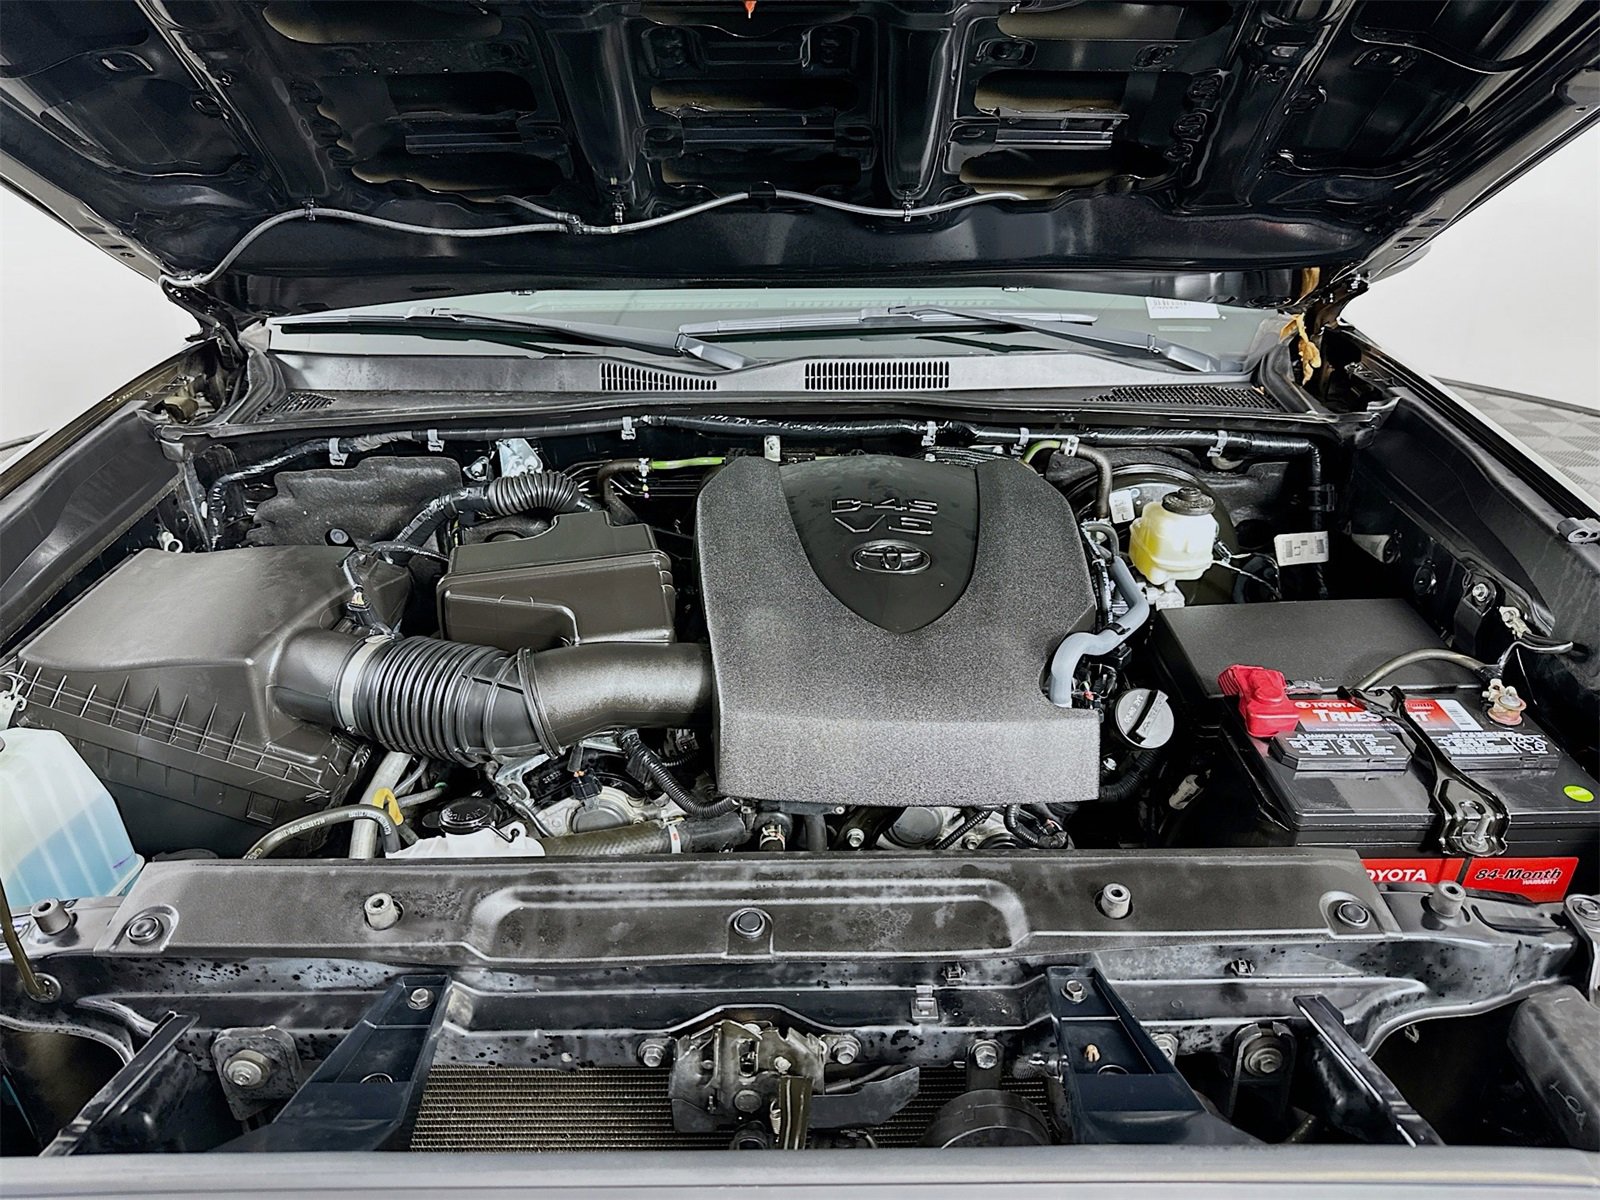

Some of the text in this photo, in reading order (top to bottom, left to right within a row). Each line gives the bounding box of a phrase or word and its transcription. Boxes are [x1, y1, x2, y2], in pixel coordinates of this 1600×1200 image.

[834, 514, 933, 534] V6
[1366, 869, 1427, 881] OYOTA
[1475, 868, 1562, 880] 84-Month
